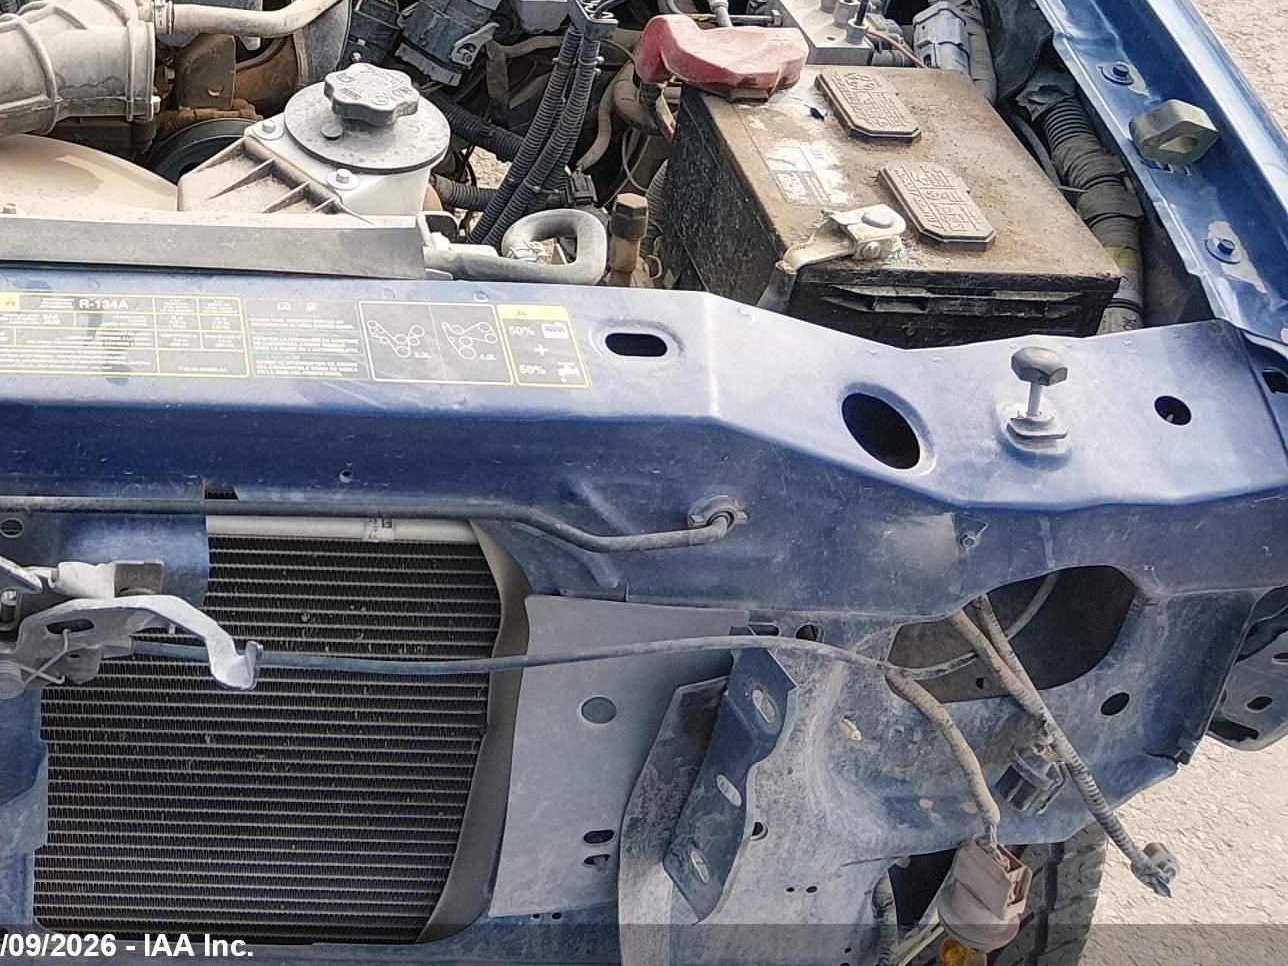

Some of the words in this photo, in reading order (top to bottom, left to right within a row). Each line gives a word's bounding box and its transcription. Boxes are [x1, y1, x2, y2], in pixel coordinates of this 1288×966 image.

[78, 297, 130, 311] R-134A
[508, 325, 537, 337] 50%
[518, 364, 548, 377] 50%
